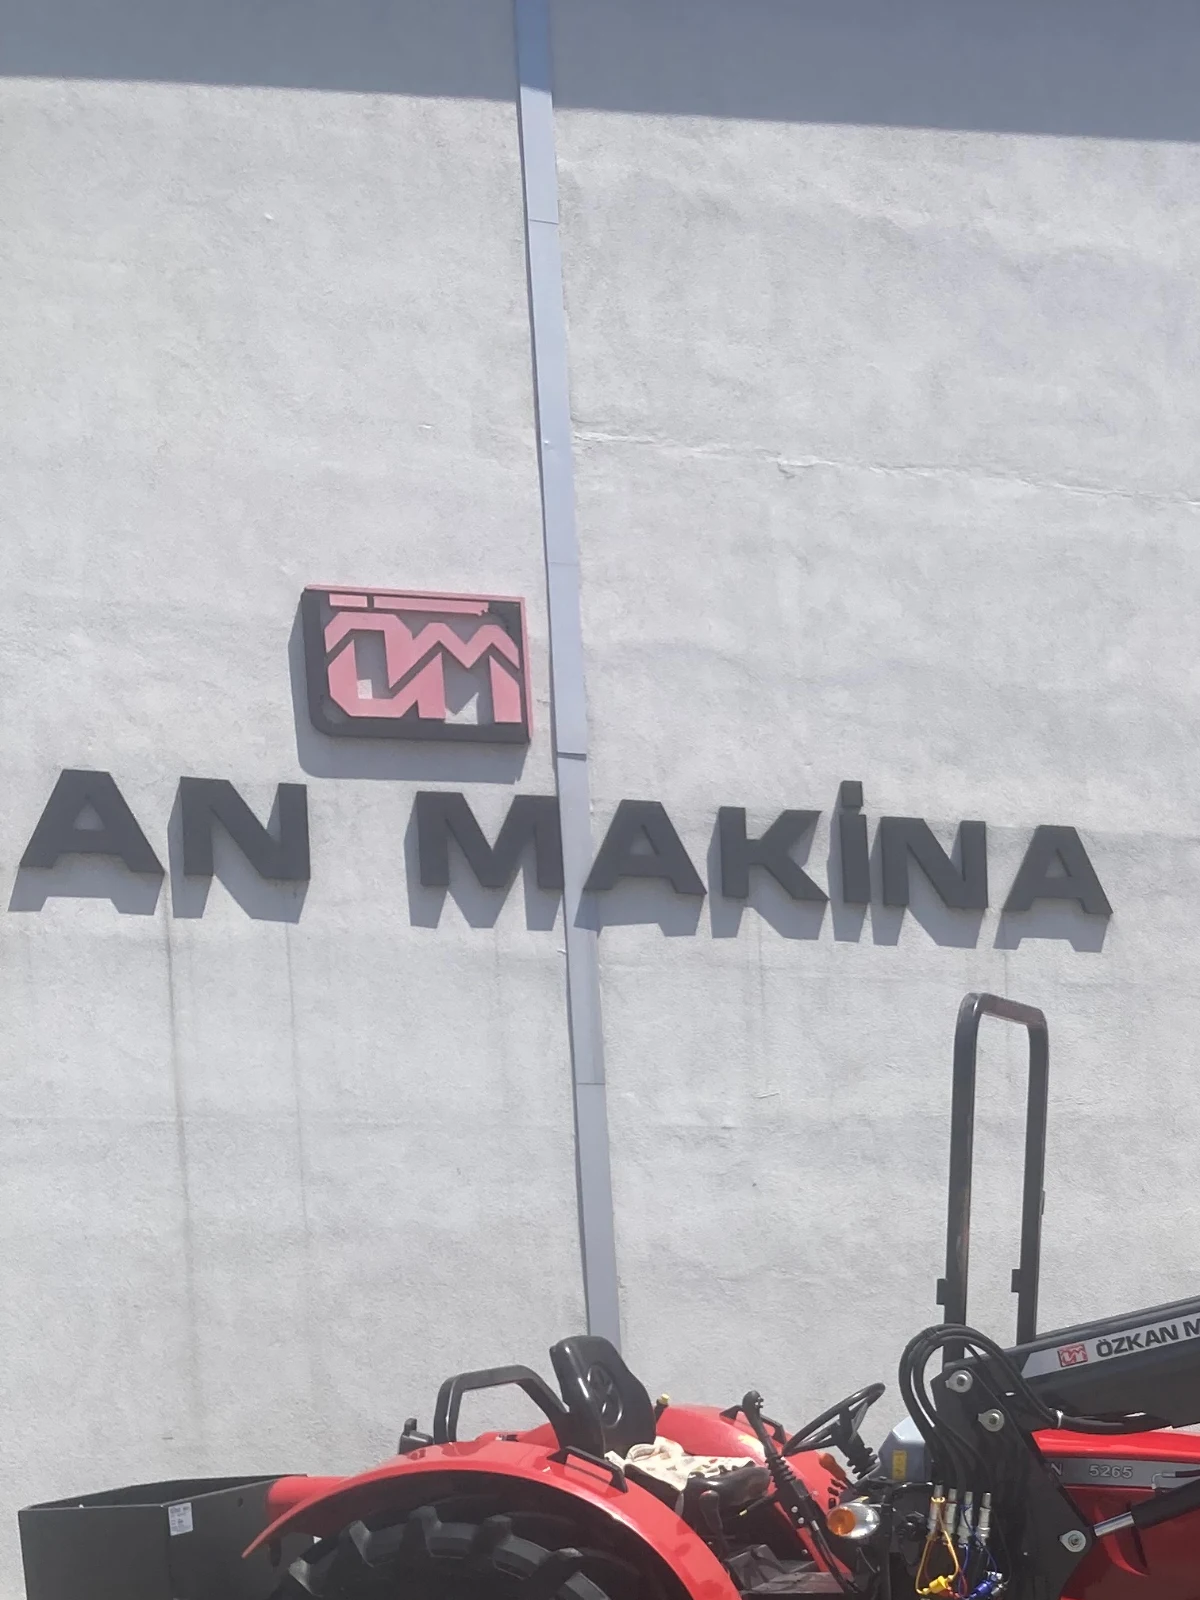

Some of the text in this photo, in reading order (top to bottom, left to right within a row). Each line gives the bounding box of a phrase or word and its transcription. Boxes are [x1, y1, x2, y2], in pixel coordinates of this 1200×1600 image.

[19, 769, 1113, 915] AN MAKİNA
[1096, 1324, 1179, 1357] ÖZKAN
[1089, 1463, 1133, 1479] 5265
